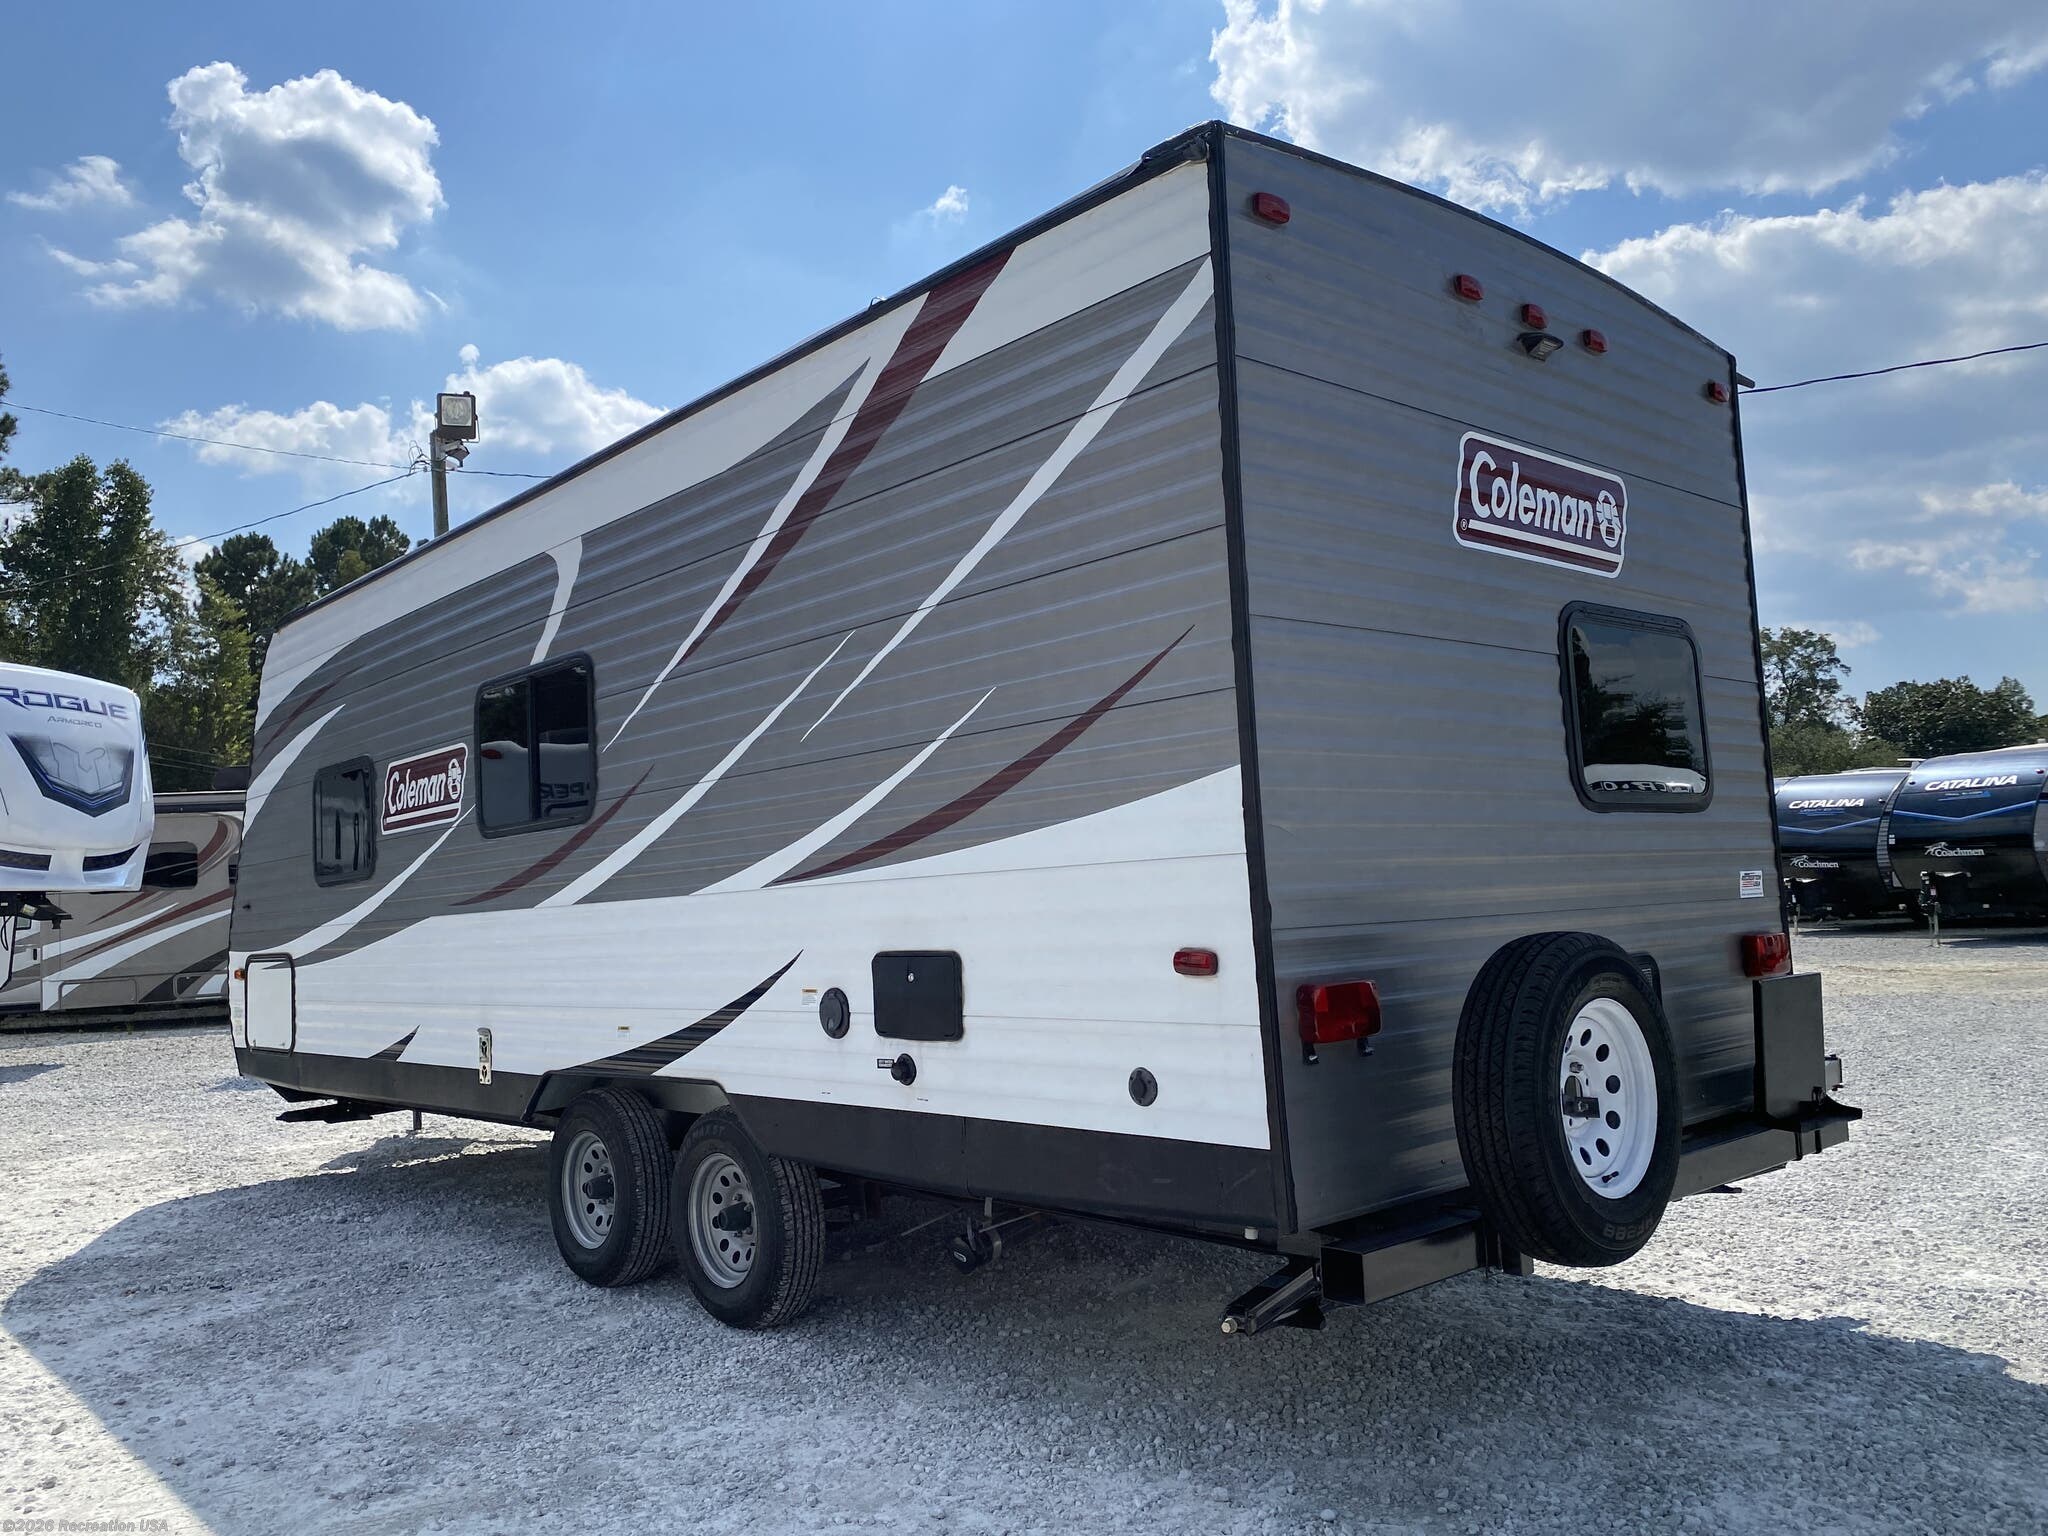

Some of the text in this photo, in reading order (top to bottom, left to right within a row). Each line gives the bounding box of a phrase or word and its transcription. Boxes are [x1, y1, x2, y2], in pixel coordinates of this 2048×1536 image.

[1469, 450, 1594, 541] Coleman
[0, 686, 129, 720] ROGUE
[1925, 775, 2018, 791] CATALINA
[387, 768, 447, 815] Coleman
[1788, 798, 1865, 809] CATALINA
[1934, 848, 1985, 857] Coachmen
[1798, 860, 1839, 869] Coachmen
